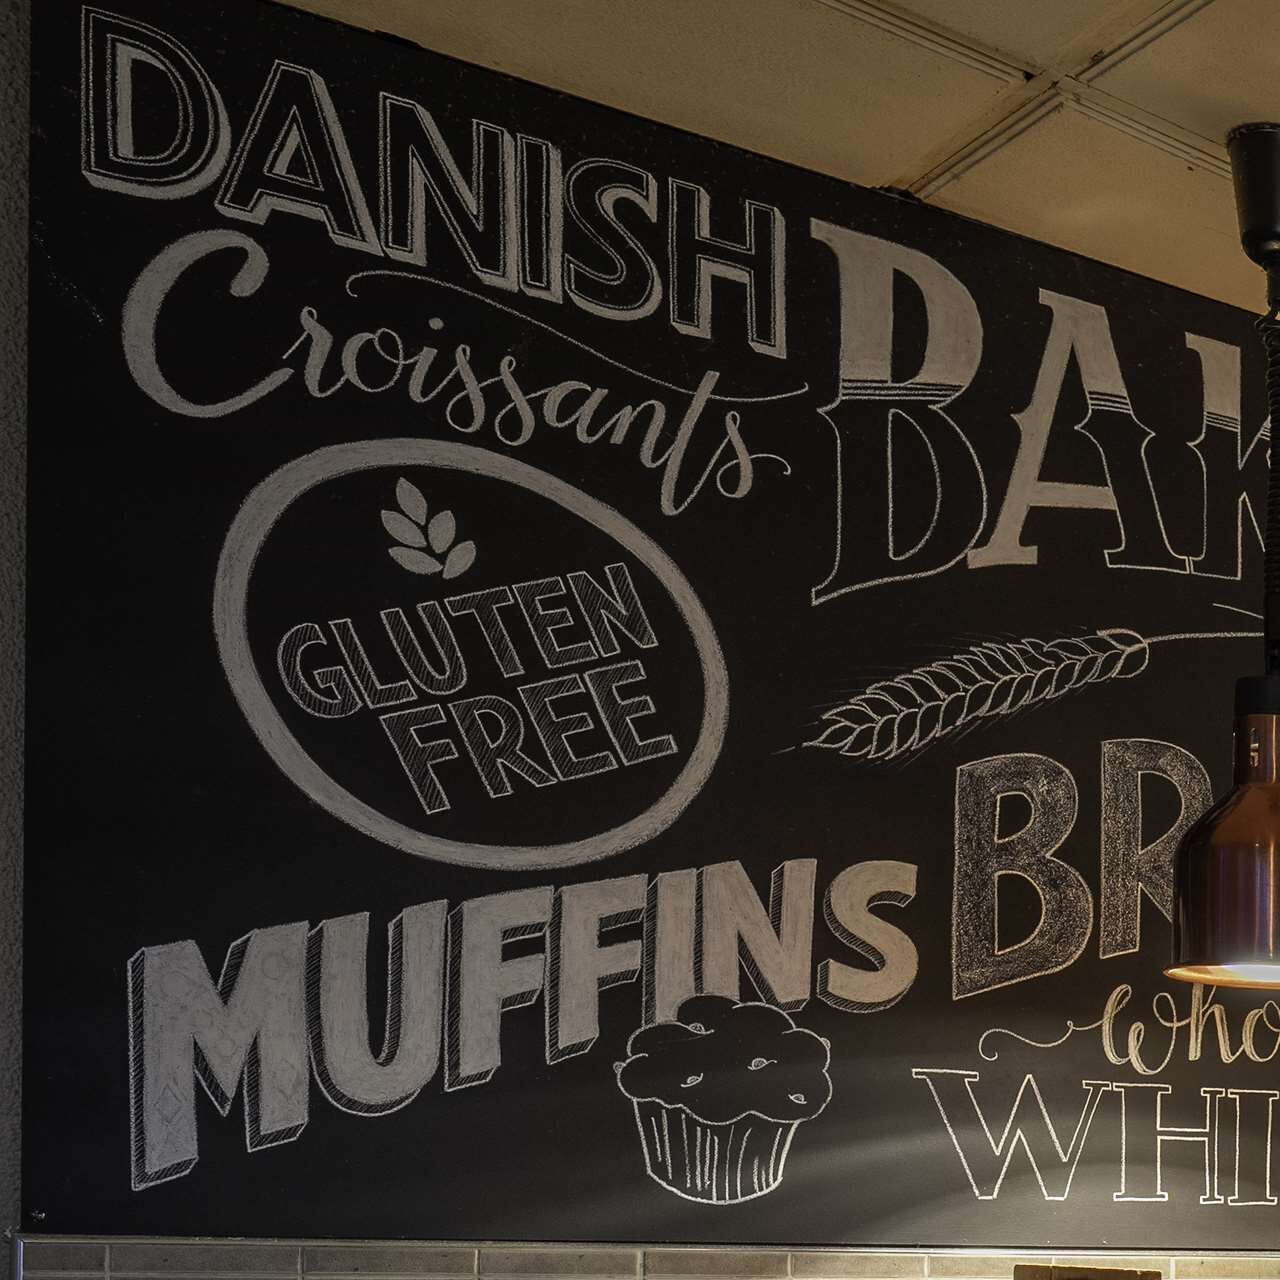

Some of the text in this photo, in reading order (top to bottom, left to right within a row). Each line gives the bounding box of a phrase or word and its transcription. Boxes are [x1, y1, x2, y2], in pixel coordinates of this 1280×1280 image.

[81, 5, 787, 359] DANISH
[121, 229, 791, 517] Croissants
[276, 563, 659, 719] GLUTEN
[379, 659, 679, 815] FREE
[127, 858, 922, 1191] MUFFINS
